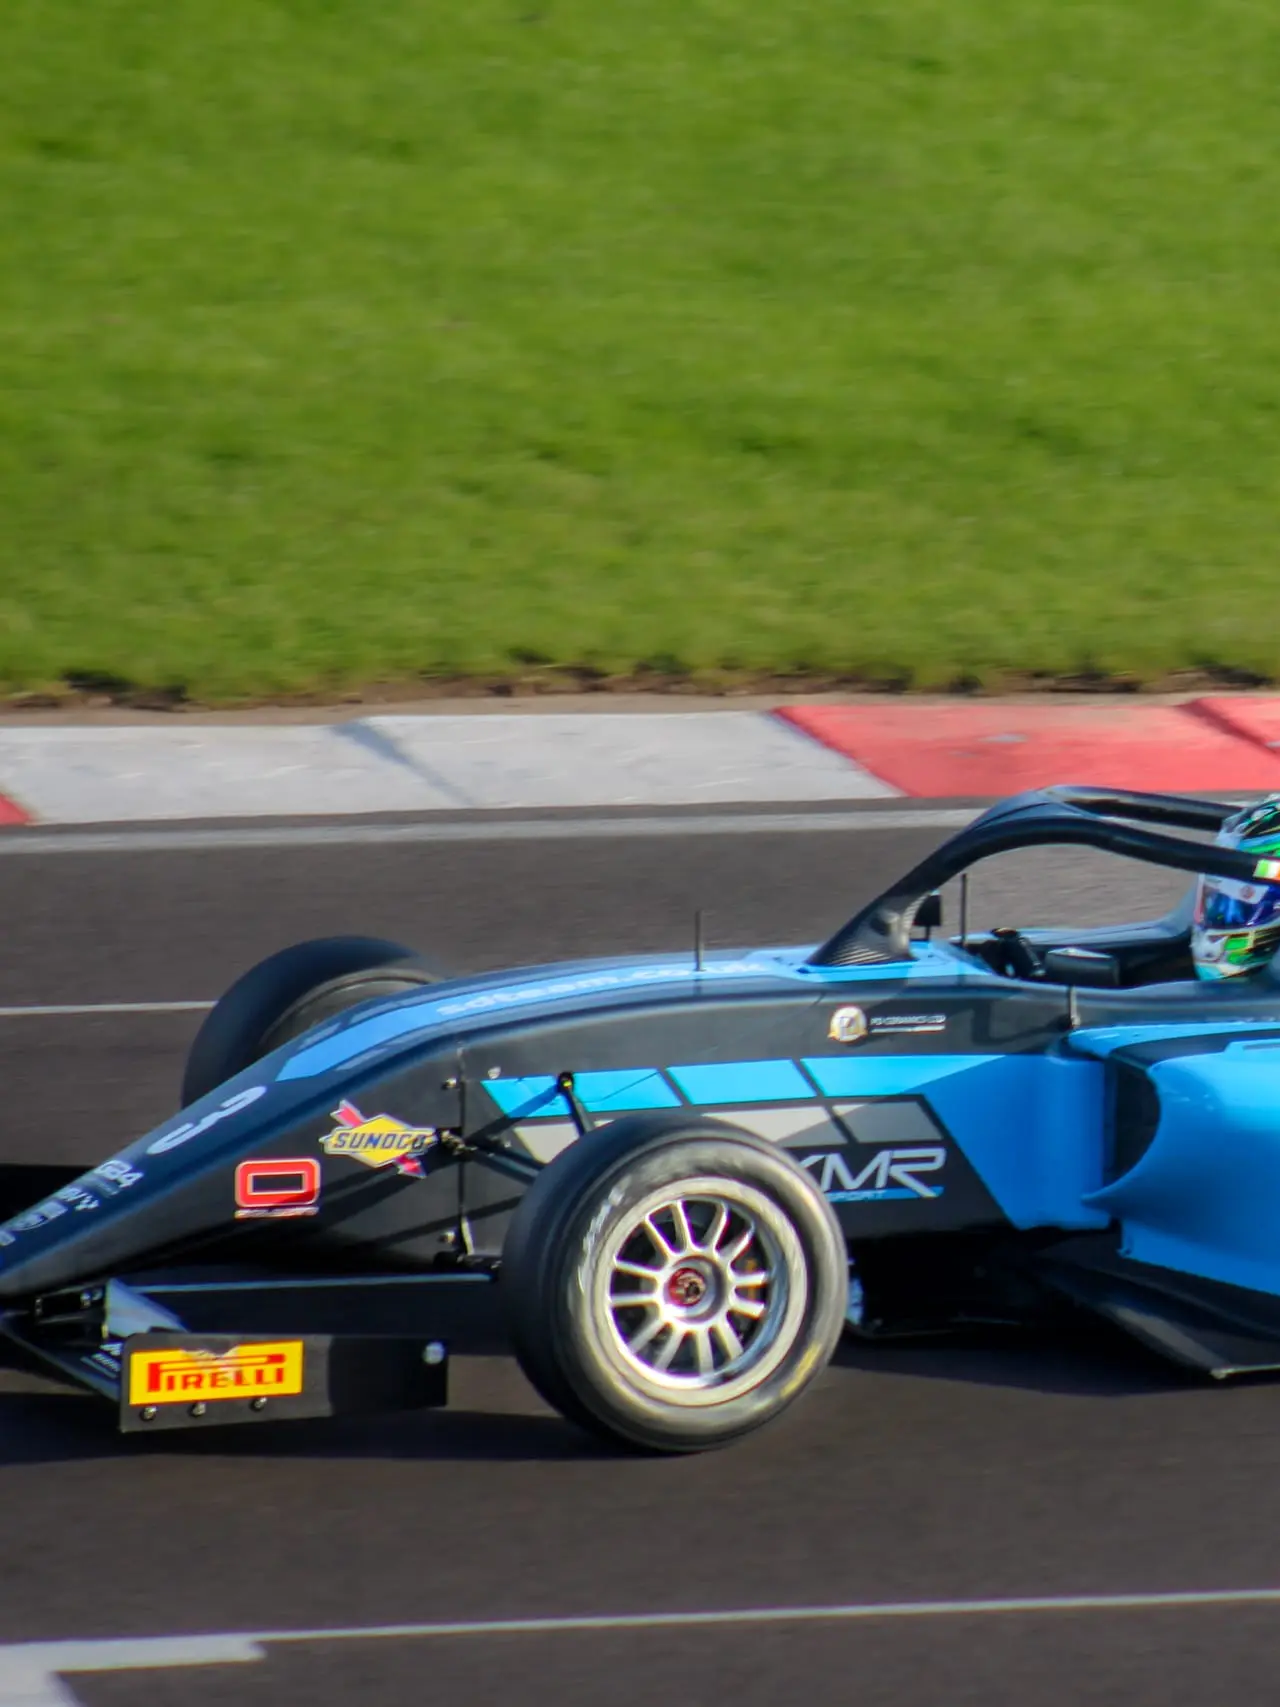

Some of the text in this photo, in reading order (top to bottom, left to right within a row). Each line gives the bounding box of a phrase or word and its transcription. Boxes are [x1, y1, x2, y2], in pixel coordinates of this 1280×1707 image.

[146, 1086, 267, 1155] 3
[334, 1132, 426, 1150] SUNOCO
[146, 1353, 286, 1393] PIRELLI
